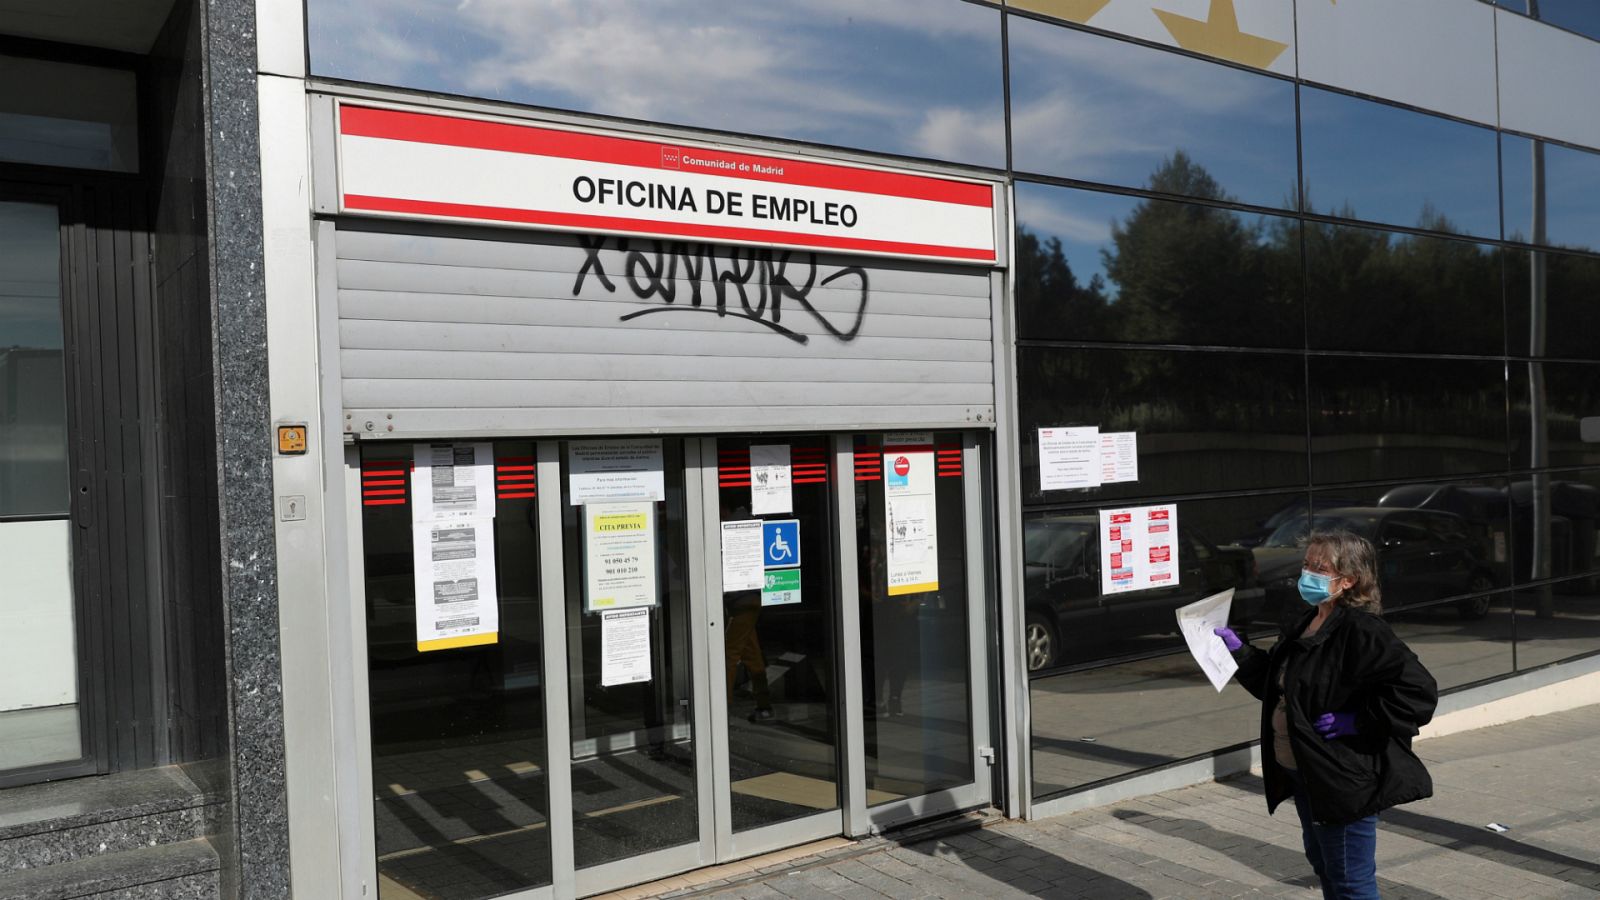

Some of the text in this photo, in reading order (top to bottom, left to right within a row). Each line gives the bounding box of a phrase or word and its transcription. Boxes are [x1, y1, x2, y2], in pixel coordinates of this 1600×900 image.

[682, 155, 784, 176] Comunidad de Madrid
[572, 175, 858, 228] OFICINA DE EMPLEO
